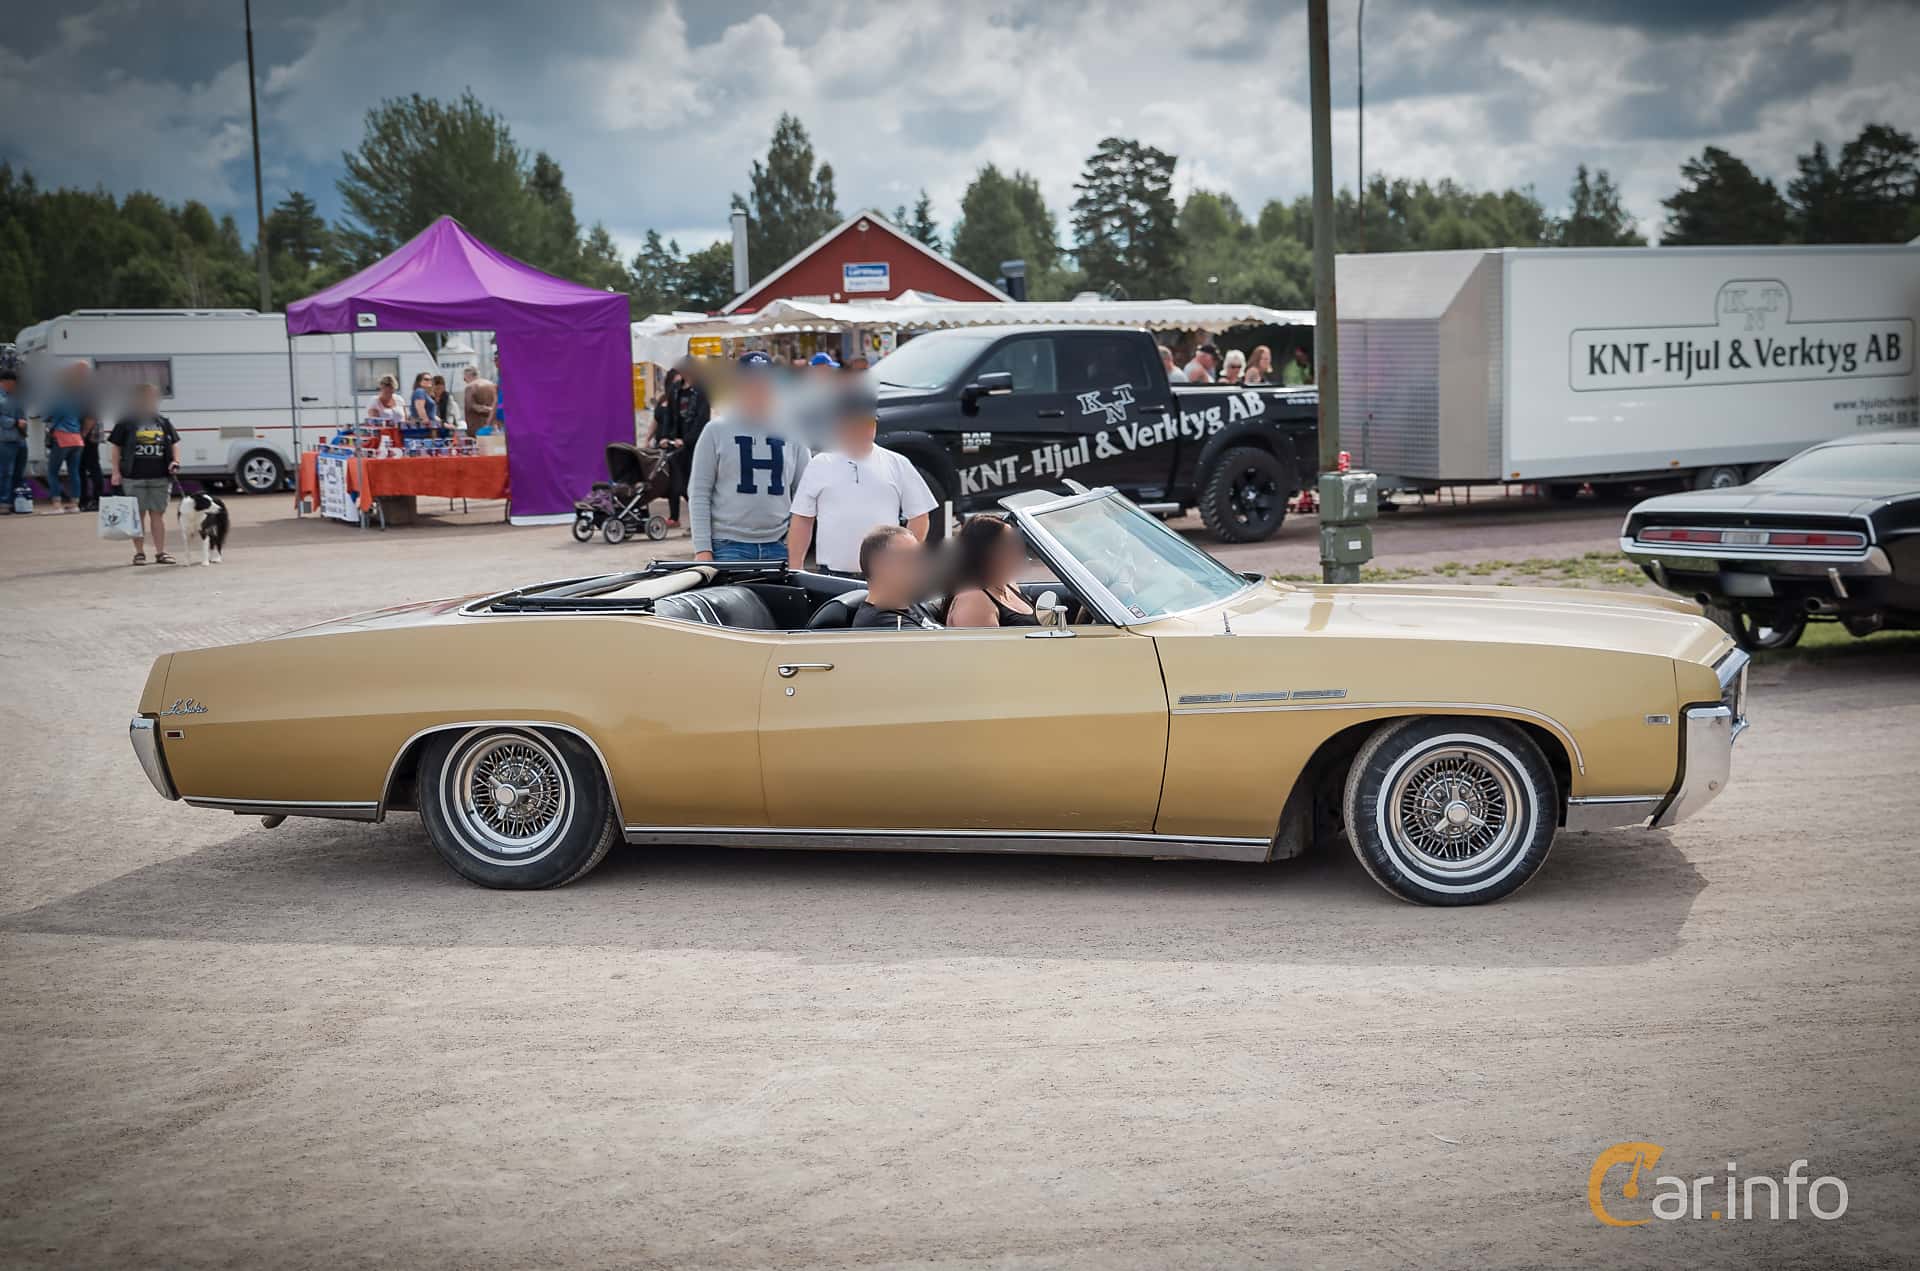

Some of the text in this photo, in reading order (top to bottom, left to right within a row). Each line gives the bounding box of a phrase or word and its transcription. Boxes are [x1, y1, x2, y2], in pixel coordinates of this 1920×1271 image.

[1588, 333, 1901, 379] KNT-Hjul & Verktyg AB
[734, 435, 786, 497] H
[957, 391, 1266, 496] KNT-Hjul & Verktyg AB
